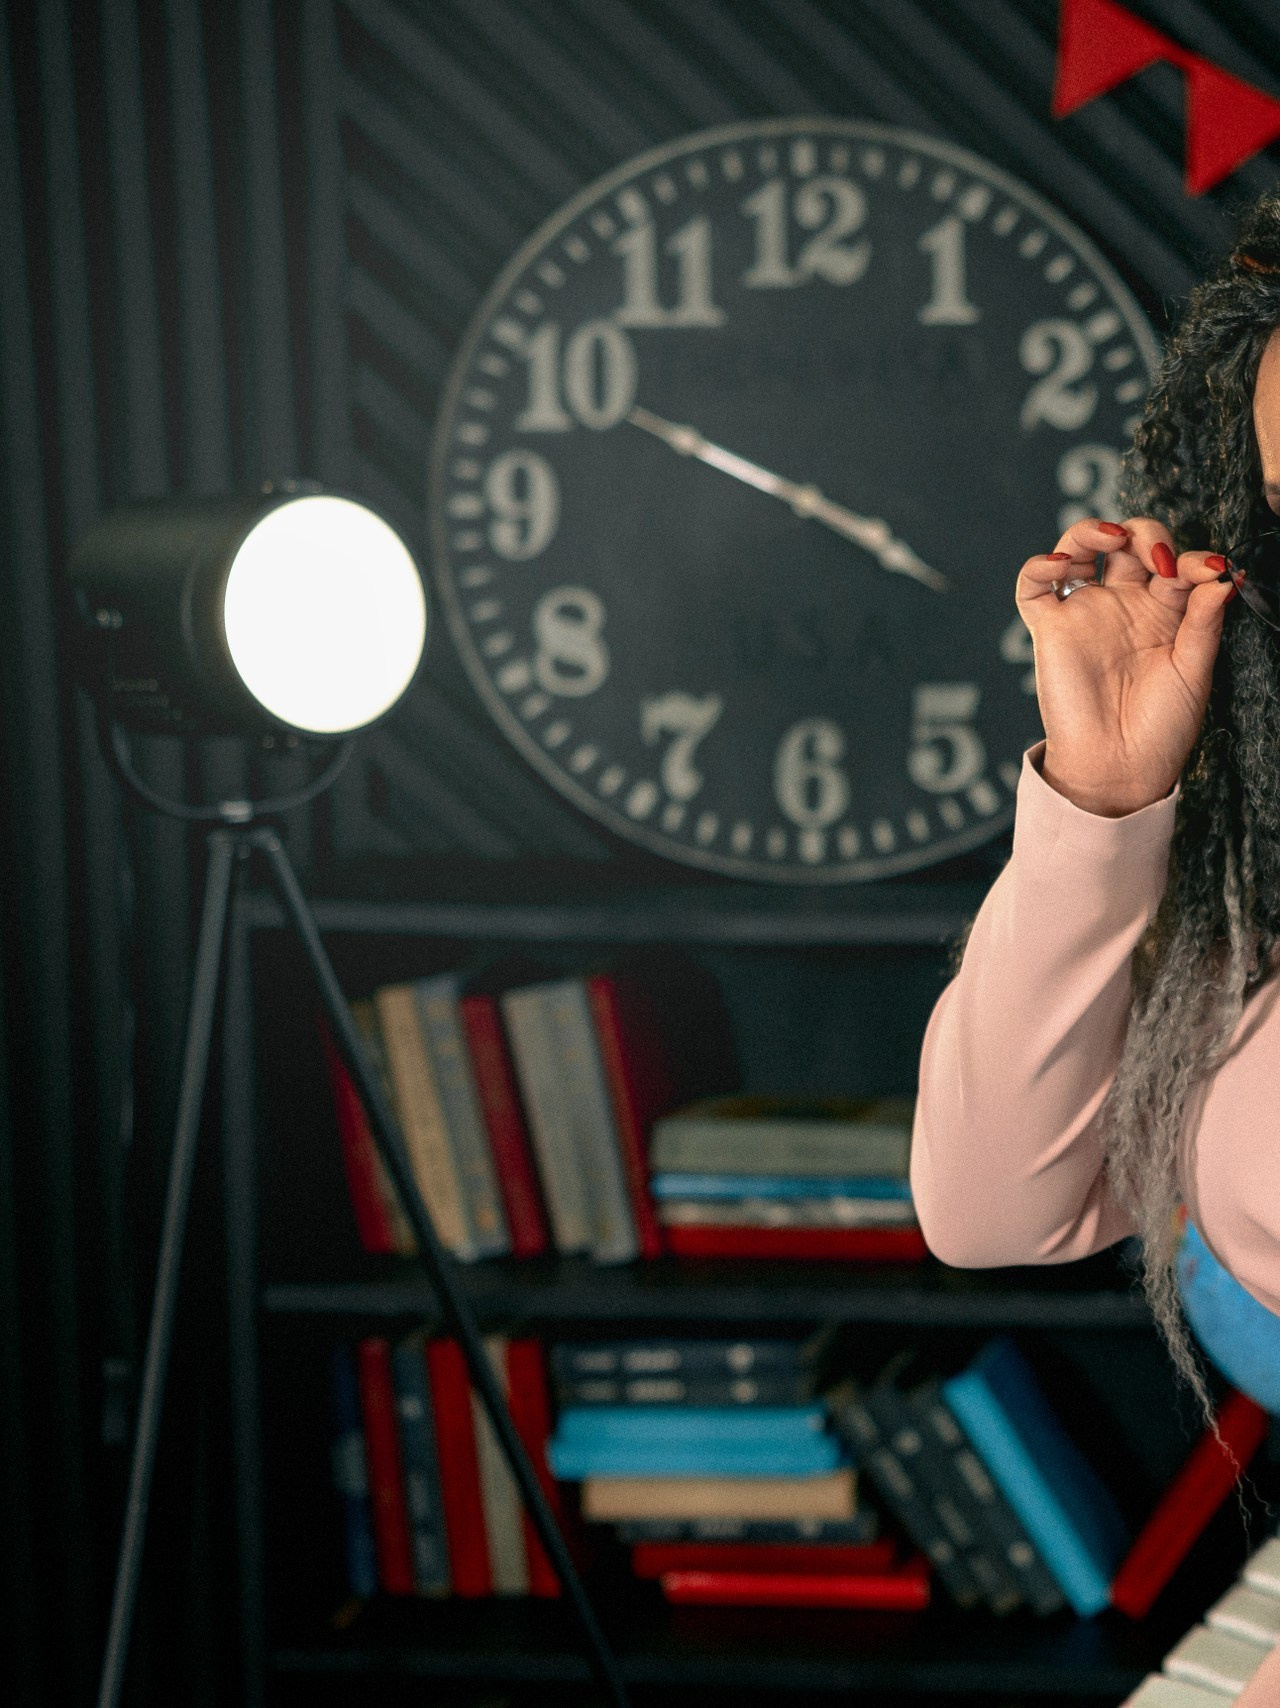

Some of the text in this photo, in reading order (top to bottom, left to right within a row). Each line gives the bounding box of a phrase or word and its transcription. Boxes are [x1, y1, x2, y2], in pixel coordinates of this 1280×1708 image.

[613, 215, 727, 327] 11
[743, 174, 871, 286] 12
[917, 215, 981, 325] 1
[516, 319, 639, 431] 10
[1020, 319, 1098, 434] 2
[486, 449, 559, 561] 9
[533, 586, 608, 698] 8
[641, 693, 724, 800] 7
[775, 717, 850, 829] 6
[909, 681, 986, 794] 5
